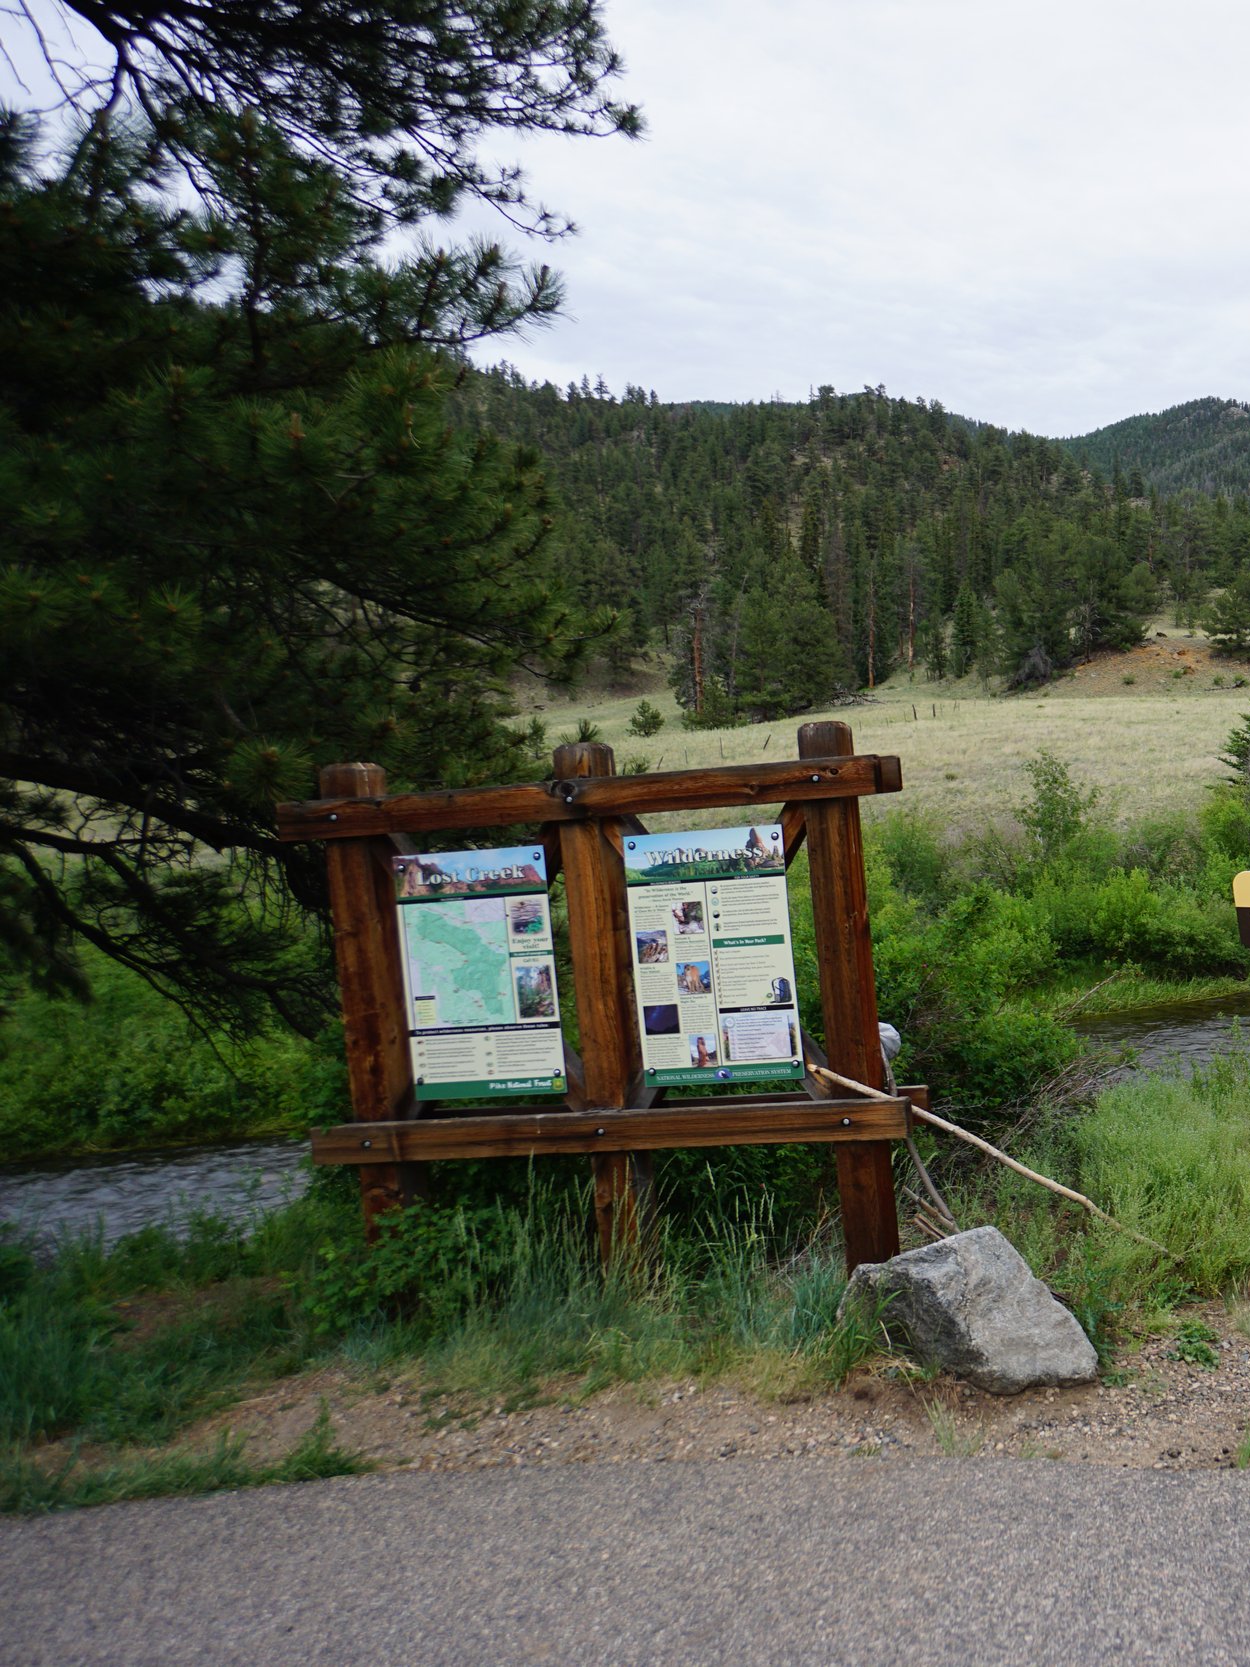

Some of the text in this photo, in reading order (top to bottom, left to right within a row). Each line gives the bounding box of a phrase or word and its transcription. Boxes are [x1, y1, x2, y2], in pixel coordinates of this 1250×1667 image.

[644, 846, 764, 867] Wilderness
[416, 864, 526, 886] Lost Creek
